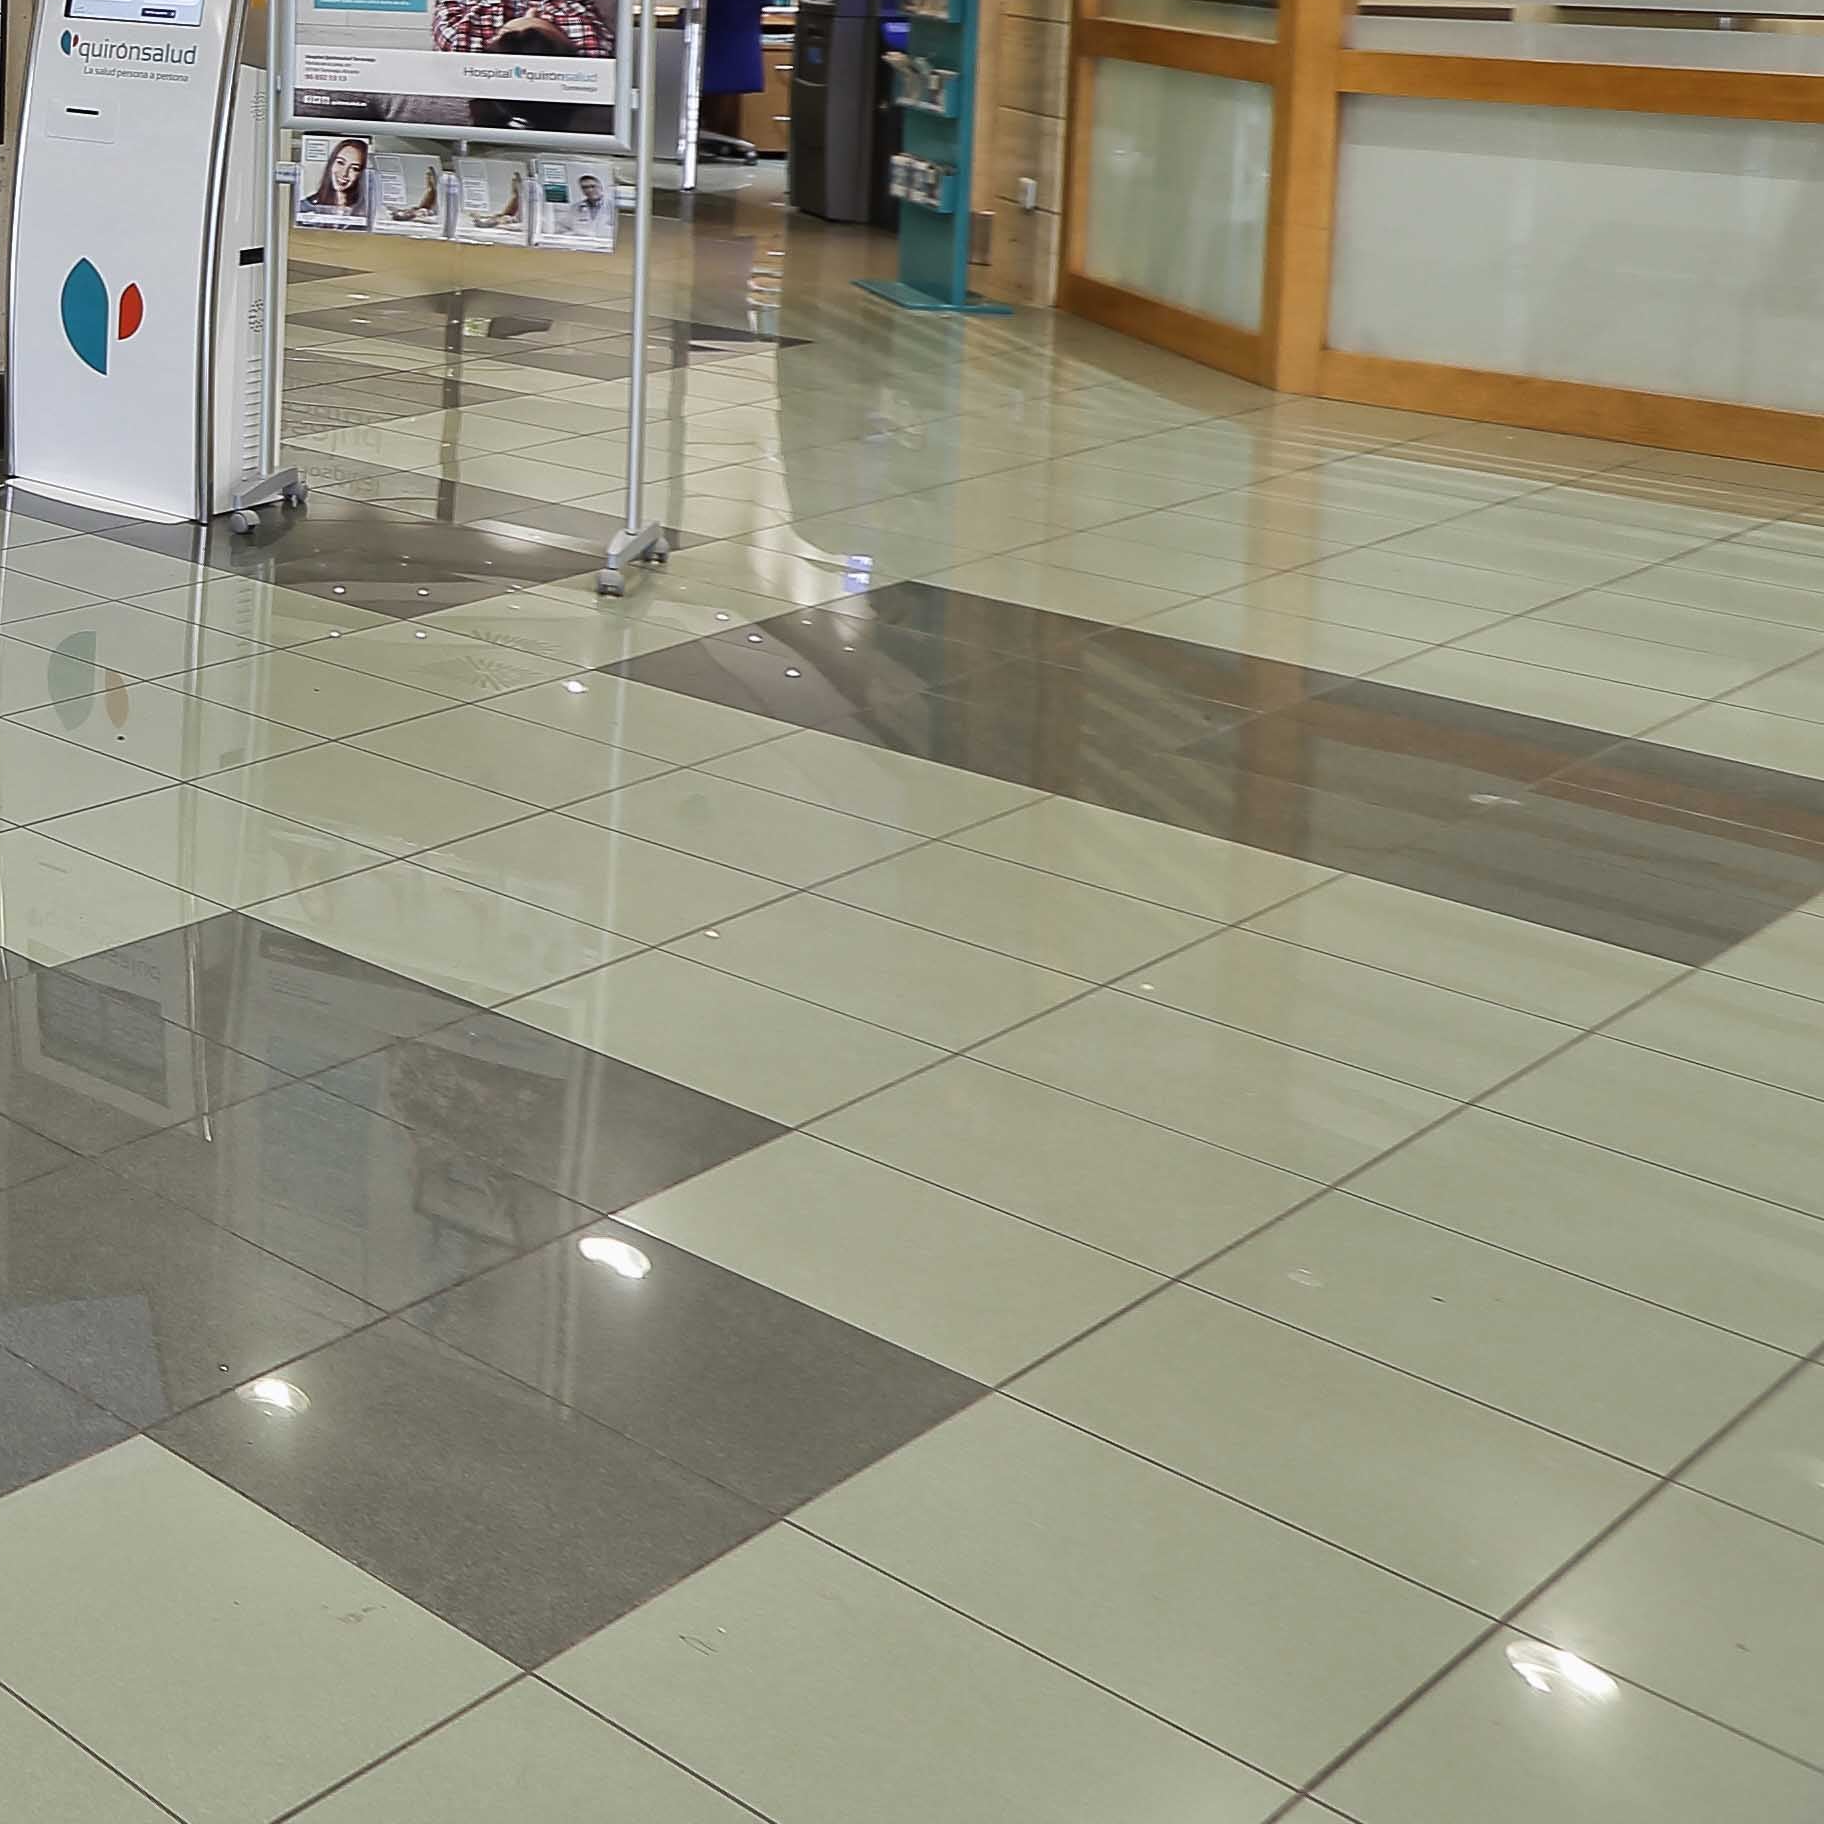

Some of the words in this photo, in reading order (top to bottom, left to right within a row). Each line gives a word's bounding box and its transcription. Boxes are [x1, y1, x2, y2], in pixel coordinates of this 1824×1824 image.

[78, 38, 197, 65] quirónsalud
[84, 66, 93, 75] La
[95, 67, 116, 77] salud
[116, 69, 148, 79] persona
[156, 72, 189, 82] persona
[464, 67, 512, 79] Hospital
